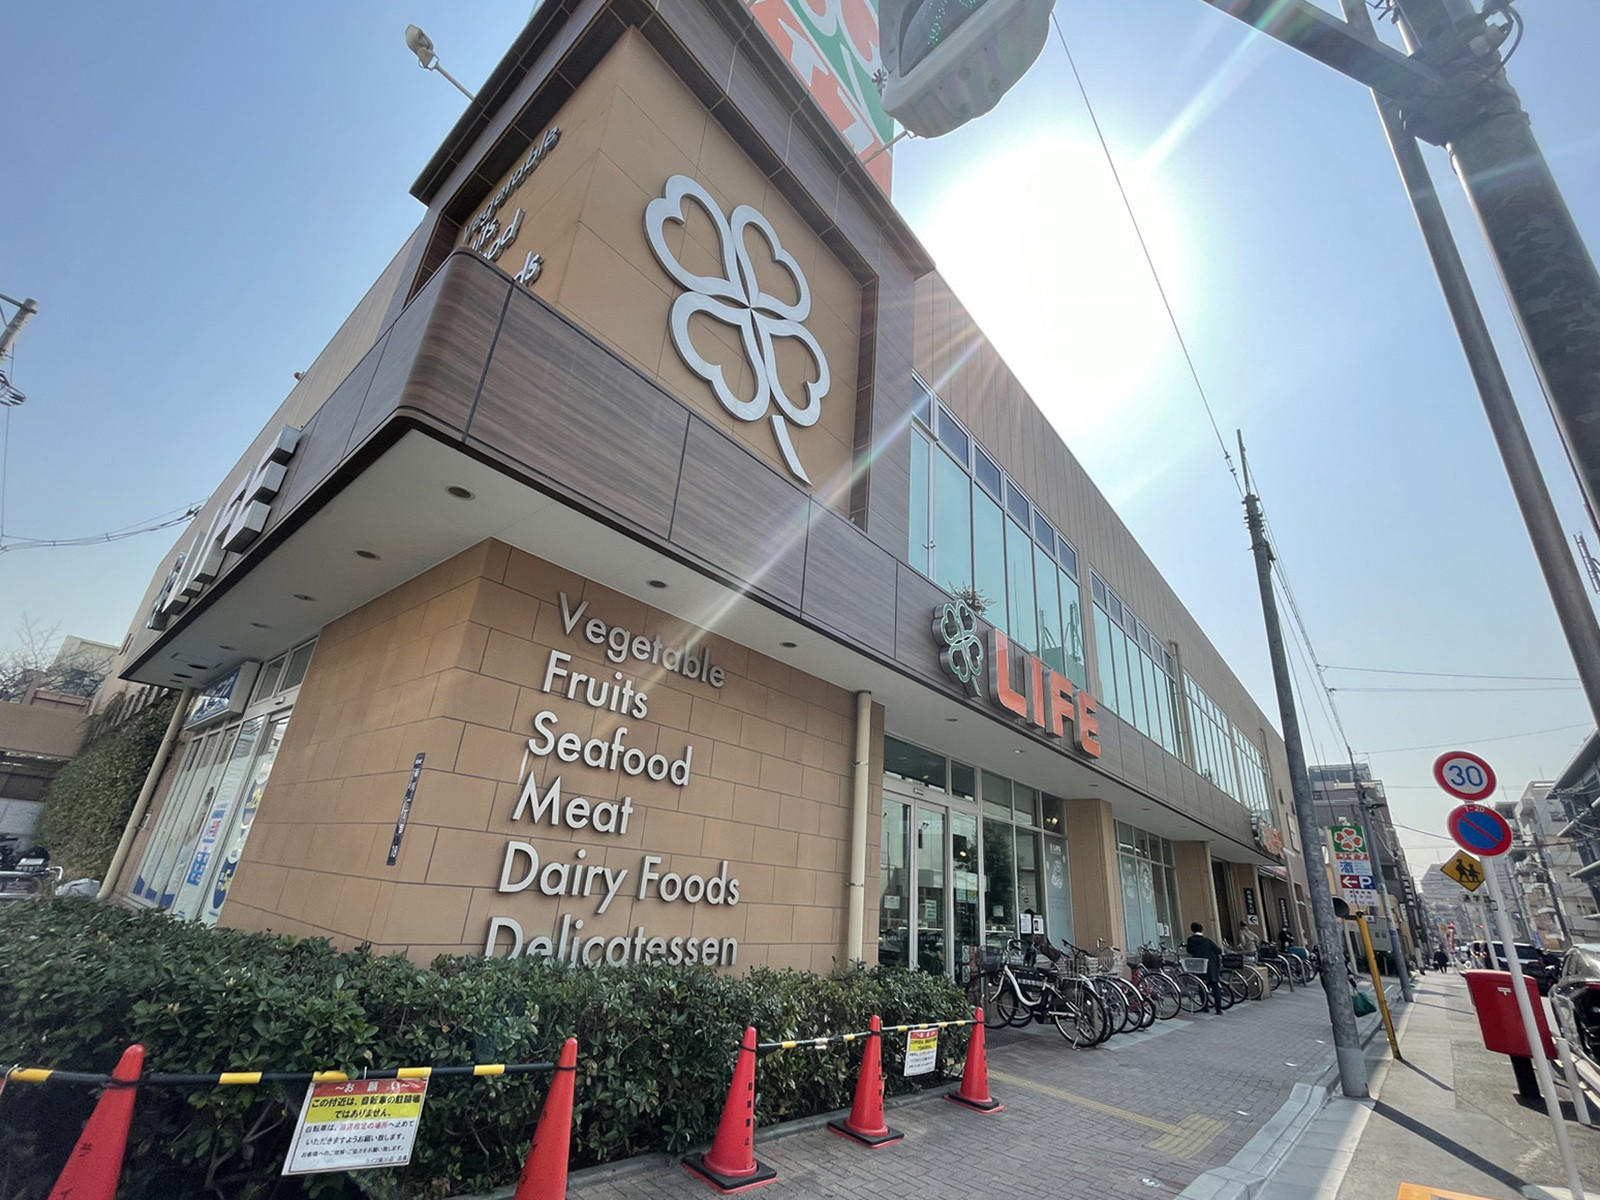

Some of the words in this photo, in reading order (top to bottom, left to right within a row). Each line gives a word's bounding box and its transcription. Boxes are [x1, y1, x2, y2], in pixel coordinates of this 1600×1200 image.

[463, 126, 561, 244] Vegetable
[558, 591, 726, 688] Vegetable
[542, 649, 649, 719] Fruits
[987, 628, 1101, 759] LIFE
[527, 710, 694, 786] Seafood
[1449, 765, 1483, 787] 30
[511, 770, 634, 834] Meat
[1464, 805, 1485, 813] 7-20
[498, 840, 628, 914] Dairy
[638, 855, 740, 906] Foods
[1359, 876, 1372, 889] P
[484, 914, 739, 968] Delicatessen
